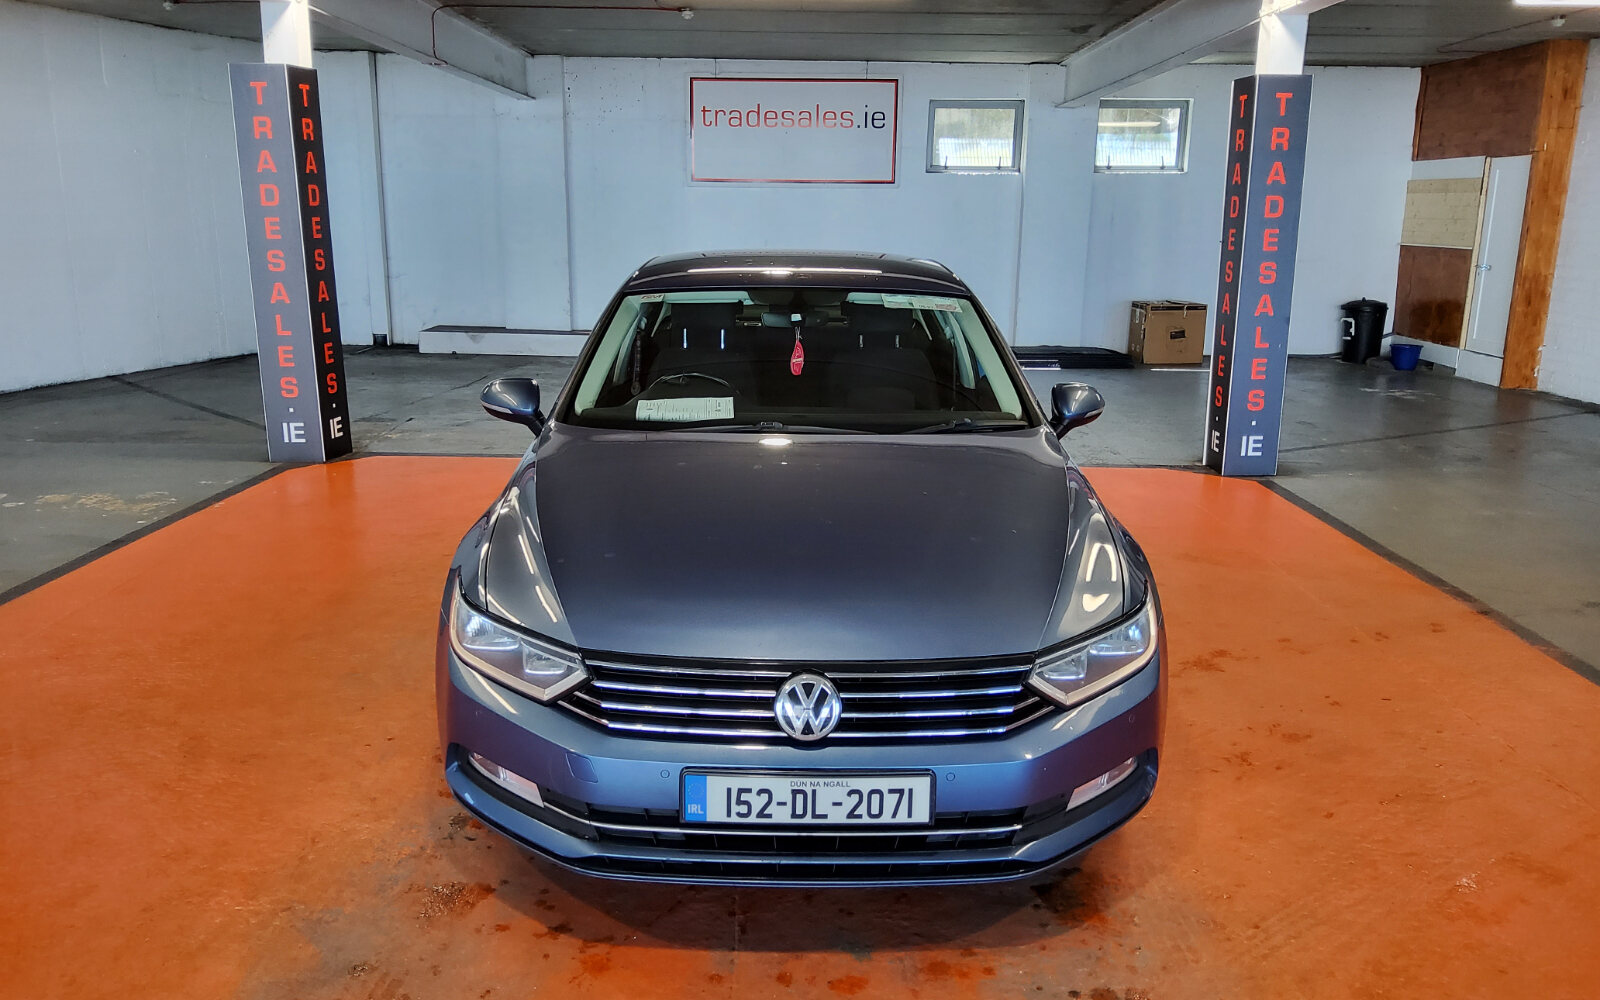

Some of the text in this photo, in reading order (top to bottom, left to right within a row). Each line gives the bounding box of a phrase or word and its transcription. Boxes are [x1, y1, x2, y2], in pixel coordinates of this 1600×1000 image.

[700, 103, 886, 129] tradesales.ie
[776, 674, 841, 740] VW
[809, 780, 821, 788] NA
[823, 780, 851, 788] NGALL
[687, 803, 705, 815] IRL
[726, 787, 914, 820] 152-DL-2071
